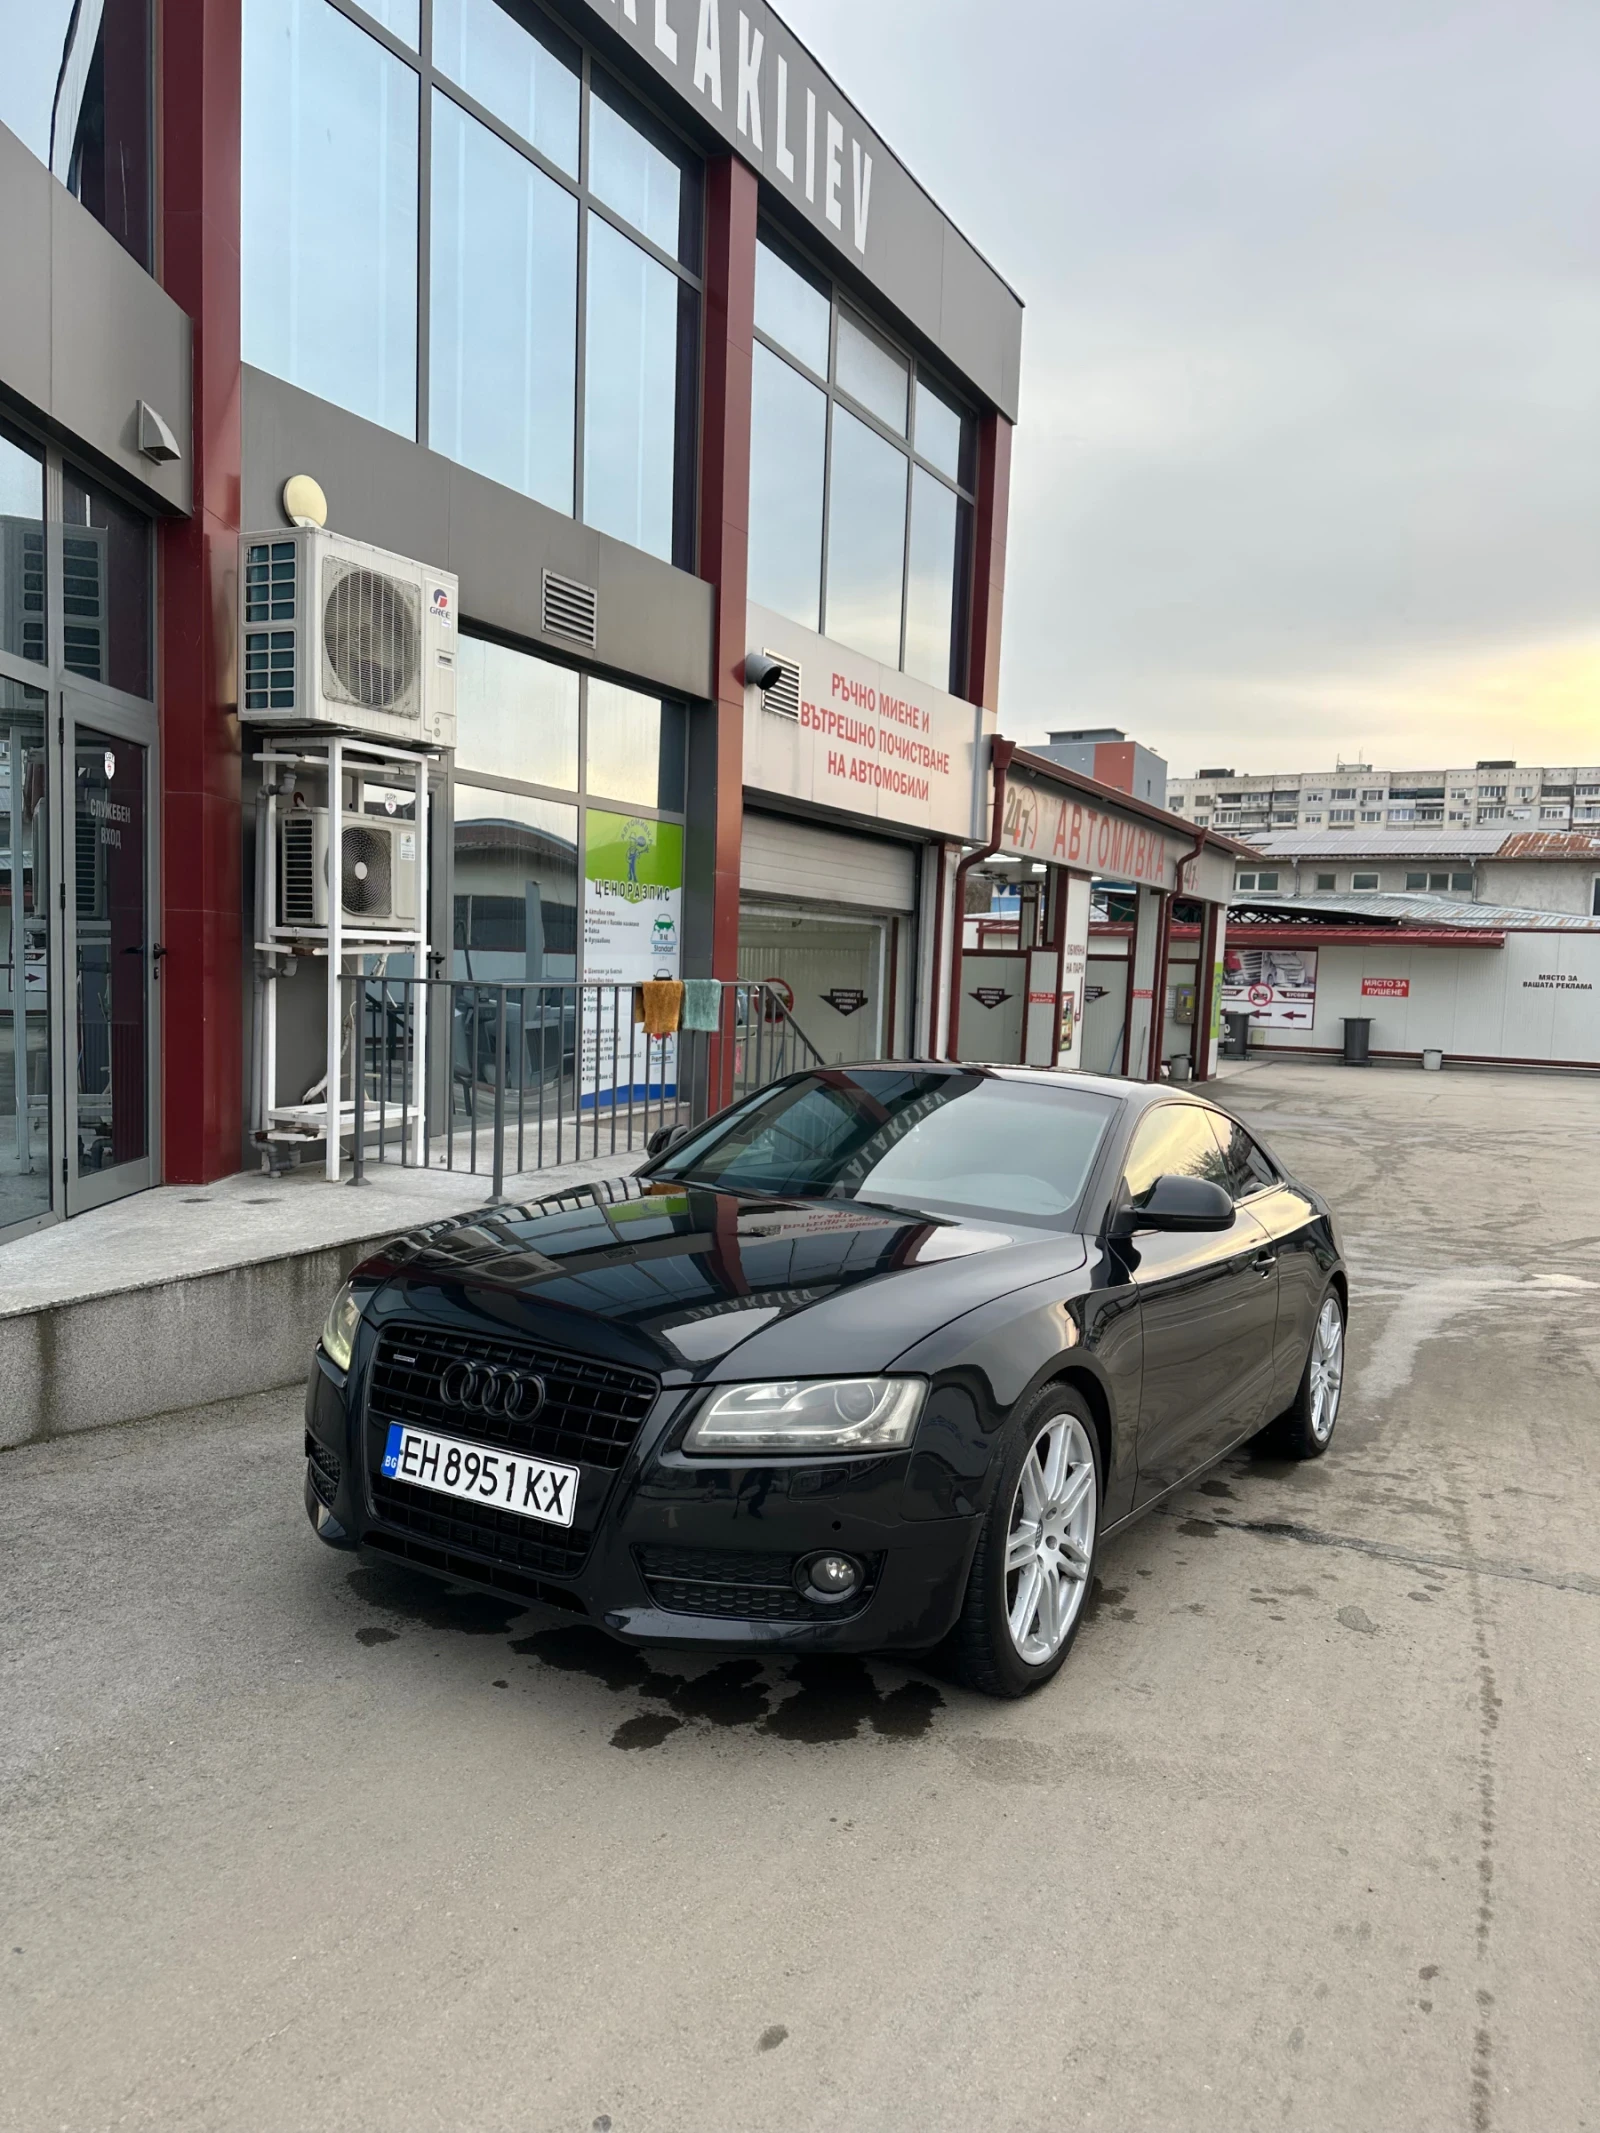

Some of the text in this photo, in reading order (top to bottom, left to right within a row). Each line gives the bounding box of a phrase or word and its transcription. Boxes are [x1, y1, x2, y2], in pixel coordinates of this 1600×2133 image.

[430, 606, 451, 619] GREE
[832, 673, 929, 733] РЪЧНО МИЕНЕ И
[801, 701, 949, 774] ВЪТРЕШНО ПОЧИСТВАНЕ
[828, 750, 929, 801] НА АВТОМОБИЛИ
[90, 799, 131, 823] СЛУЖЕБЕН
[101, 829, 121, 849] ВХОД
[1053, 800, 1165, 883] АВТОМИВКА
[595, 879, 670, 901] ЦЕНОРАЗПИС
[1523, 981, 1593, 990] ВАШАТА РЕКЛАМА
[385, 1455, 397, 1469] BG
